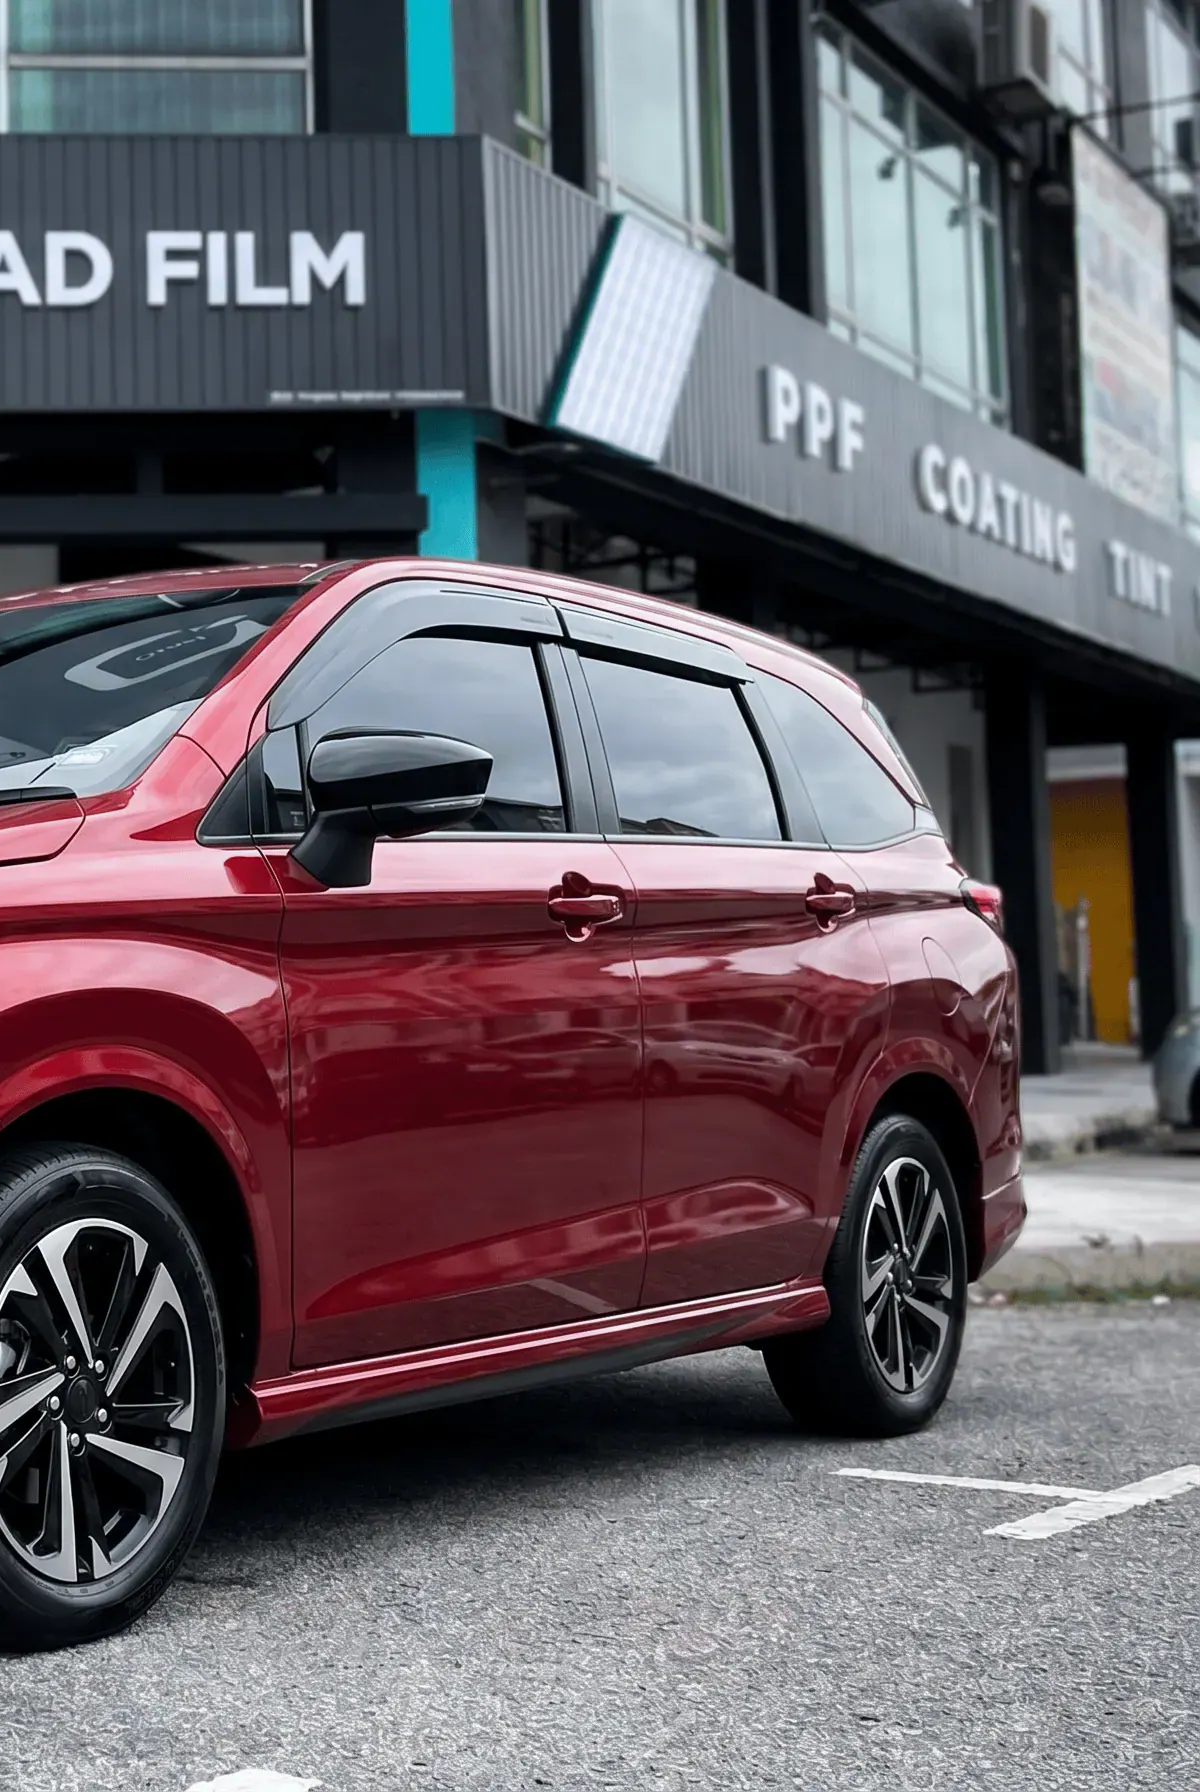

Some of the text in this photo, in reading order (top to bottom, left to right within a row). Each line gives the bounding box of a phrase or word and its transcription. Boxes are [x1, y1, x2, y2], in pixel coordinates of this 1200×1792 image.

[146, 230, 366, 308] FILM
[768, 363, 1173, 617] PPF COATING TINT
